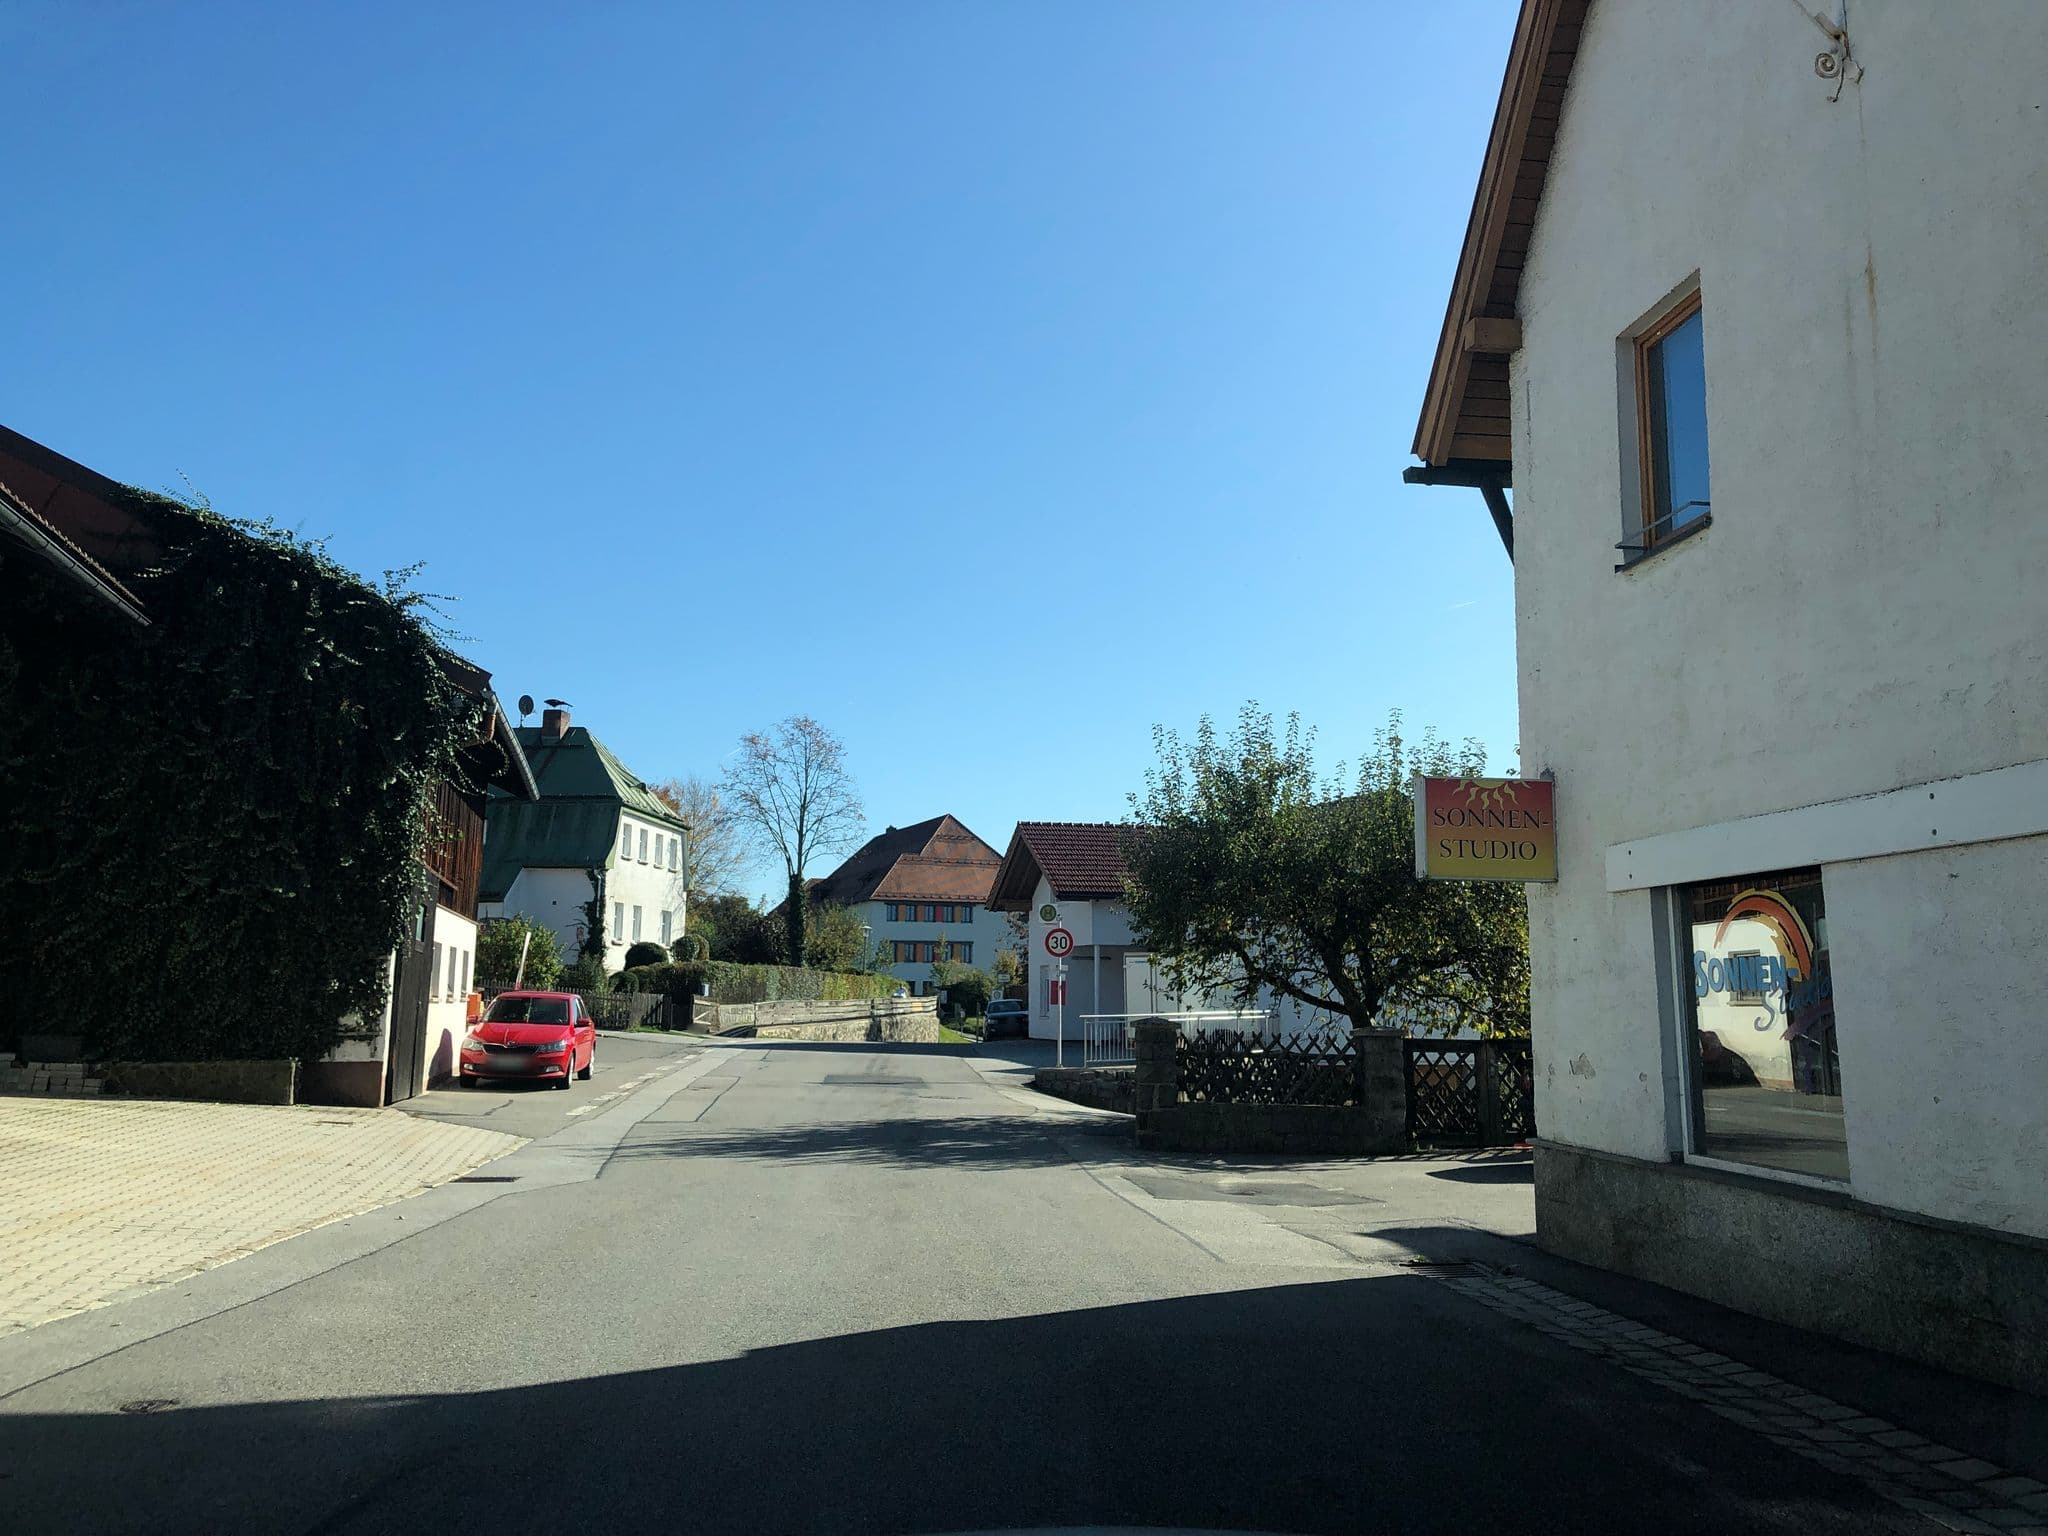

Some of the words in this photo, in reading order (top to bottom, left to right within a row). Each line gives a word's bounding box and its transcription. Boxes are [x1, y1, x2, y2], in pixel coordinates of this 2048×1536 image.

[1433, 807, 1549, 829] SONNEN-
[1439, 838, 1537, 860] STUDIO
[1050, 936, 1068, 950] 30
[1693, 950, 1800, 998] SONNEN-
